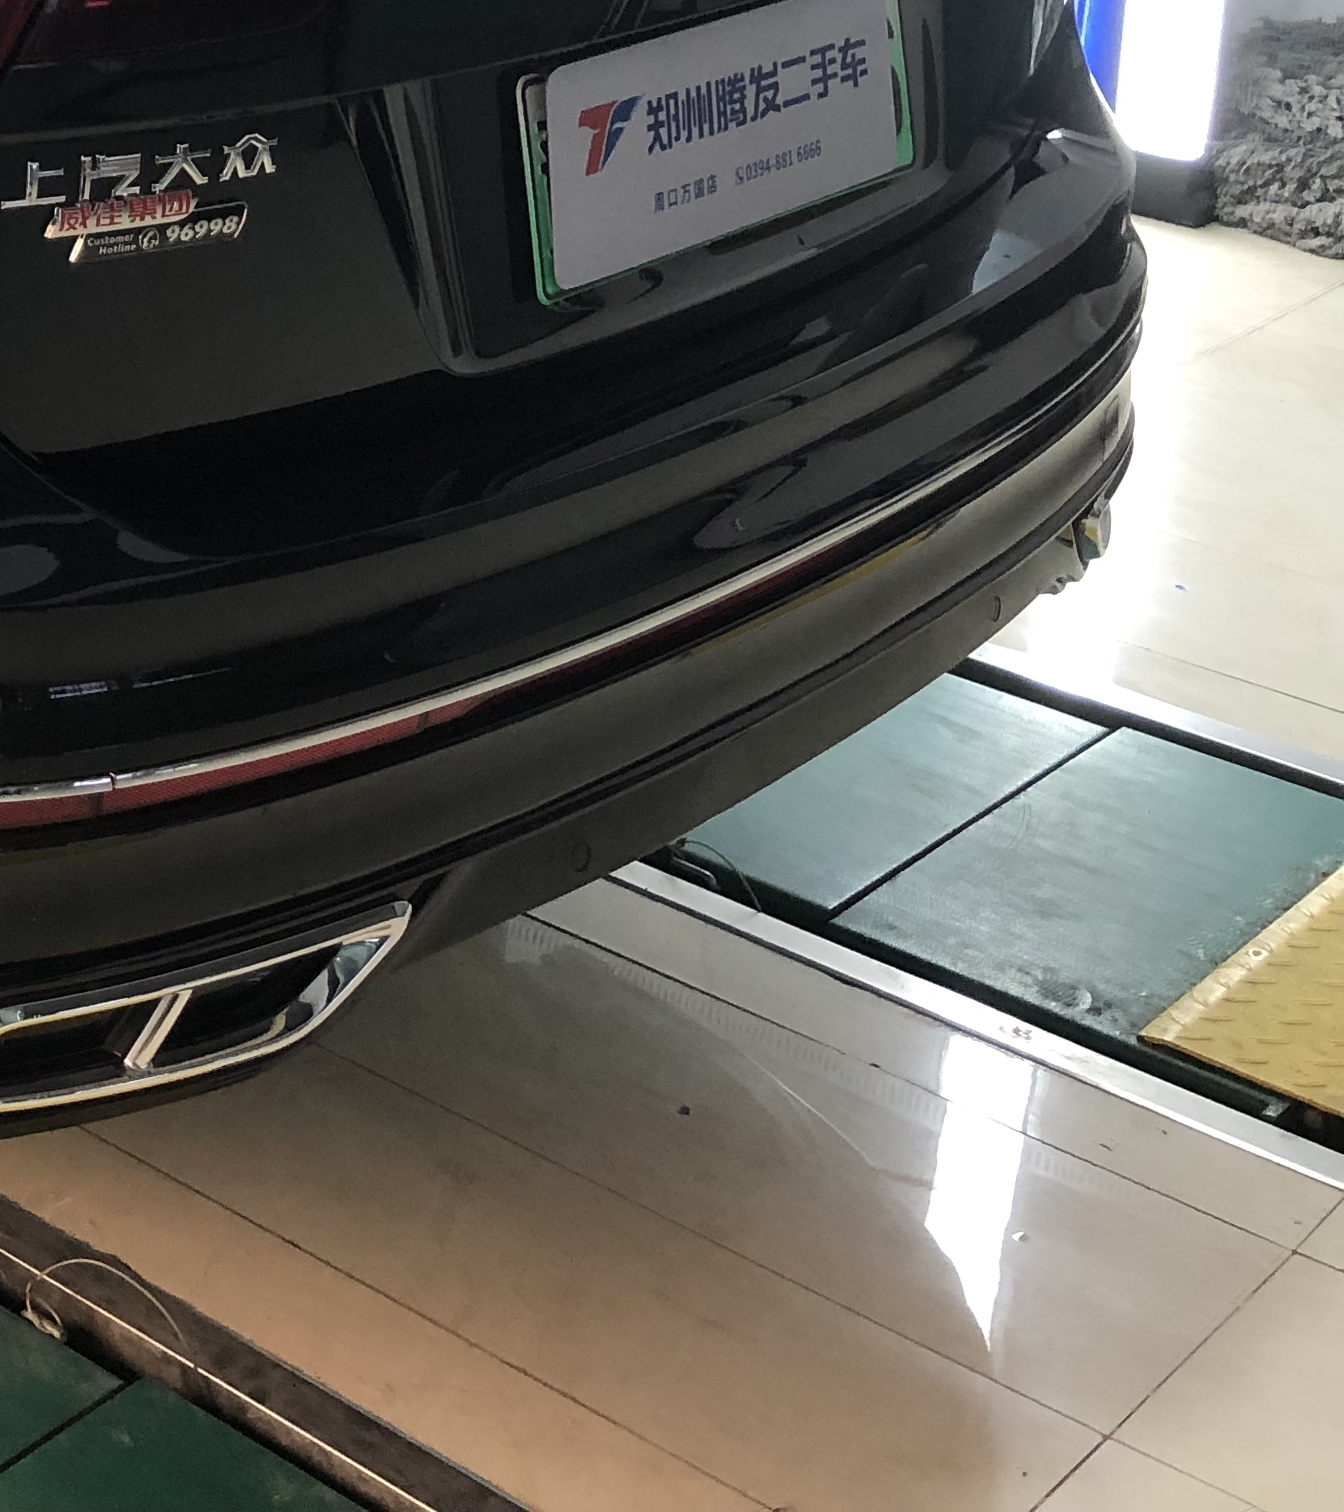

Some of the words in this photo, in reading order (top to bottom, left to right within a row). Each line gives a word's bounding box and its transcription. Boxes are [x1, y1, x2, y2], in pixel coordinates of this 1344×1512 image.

[645, 36, 869, 156] 郑州腾发二手车
[0, 133, 279, 210] 上汽大众
[87, 232, 134, 247] Customer
[165, 214, 240, 242] 96998
[99, 243, 137, 255] Hotline
